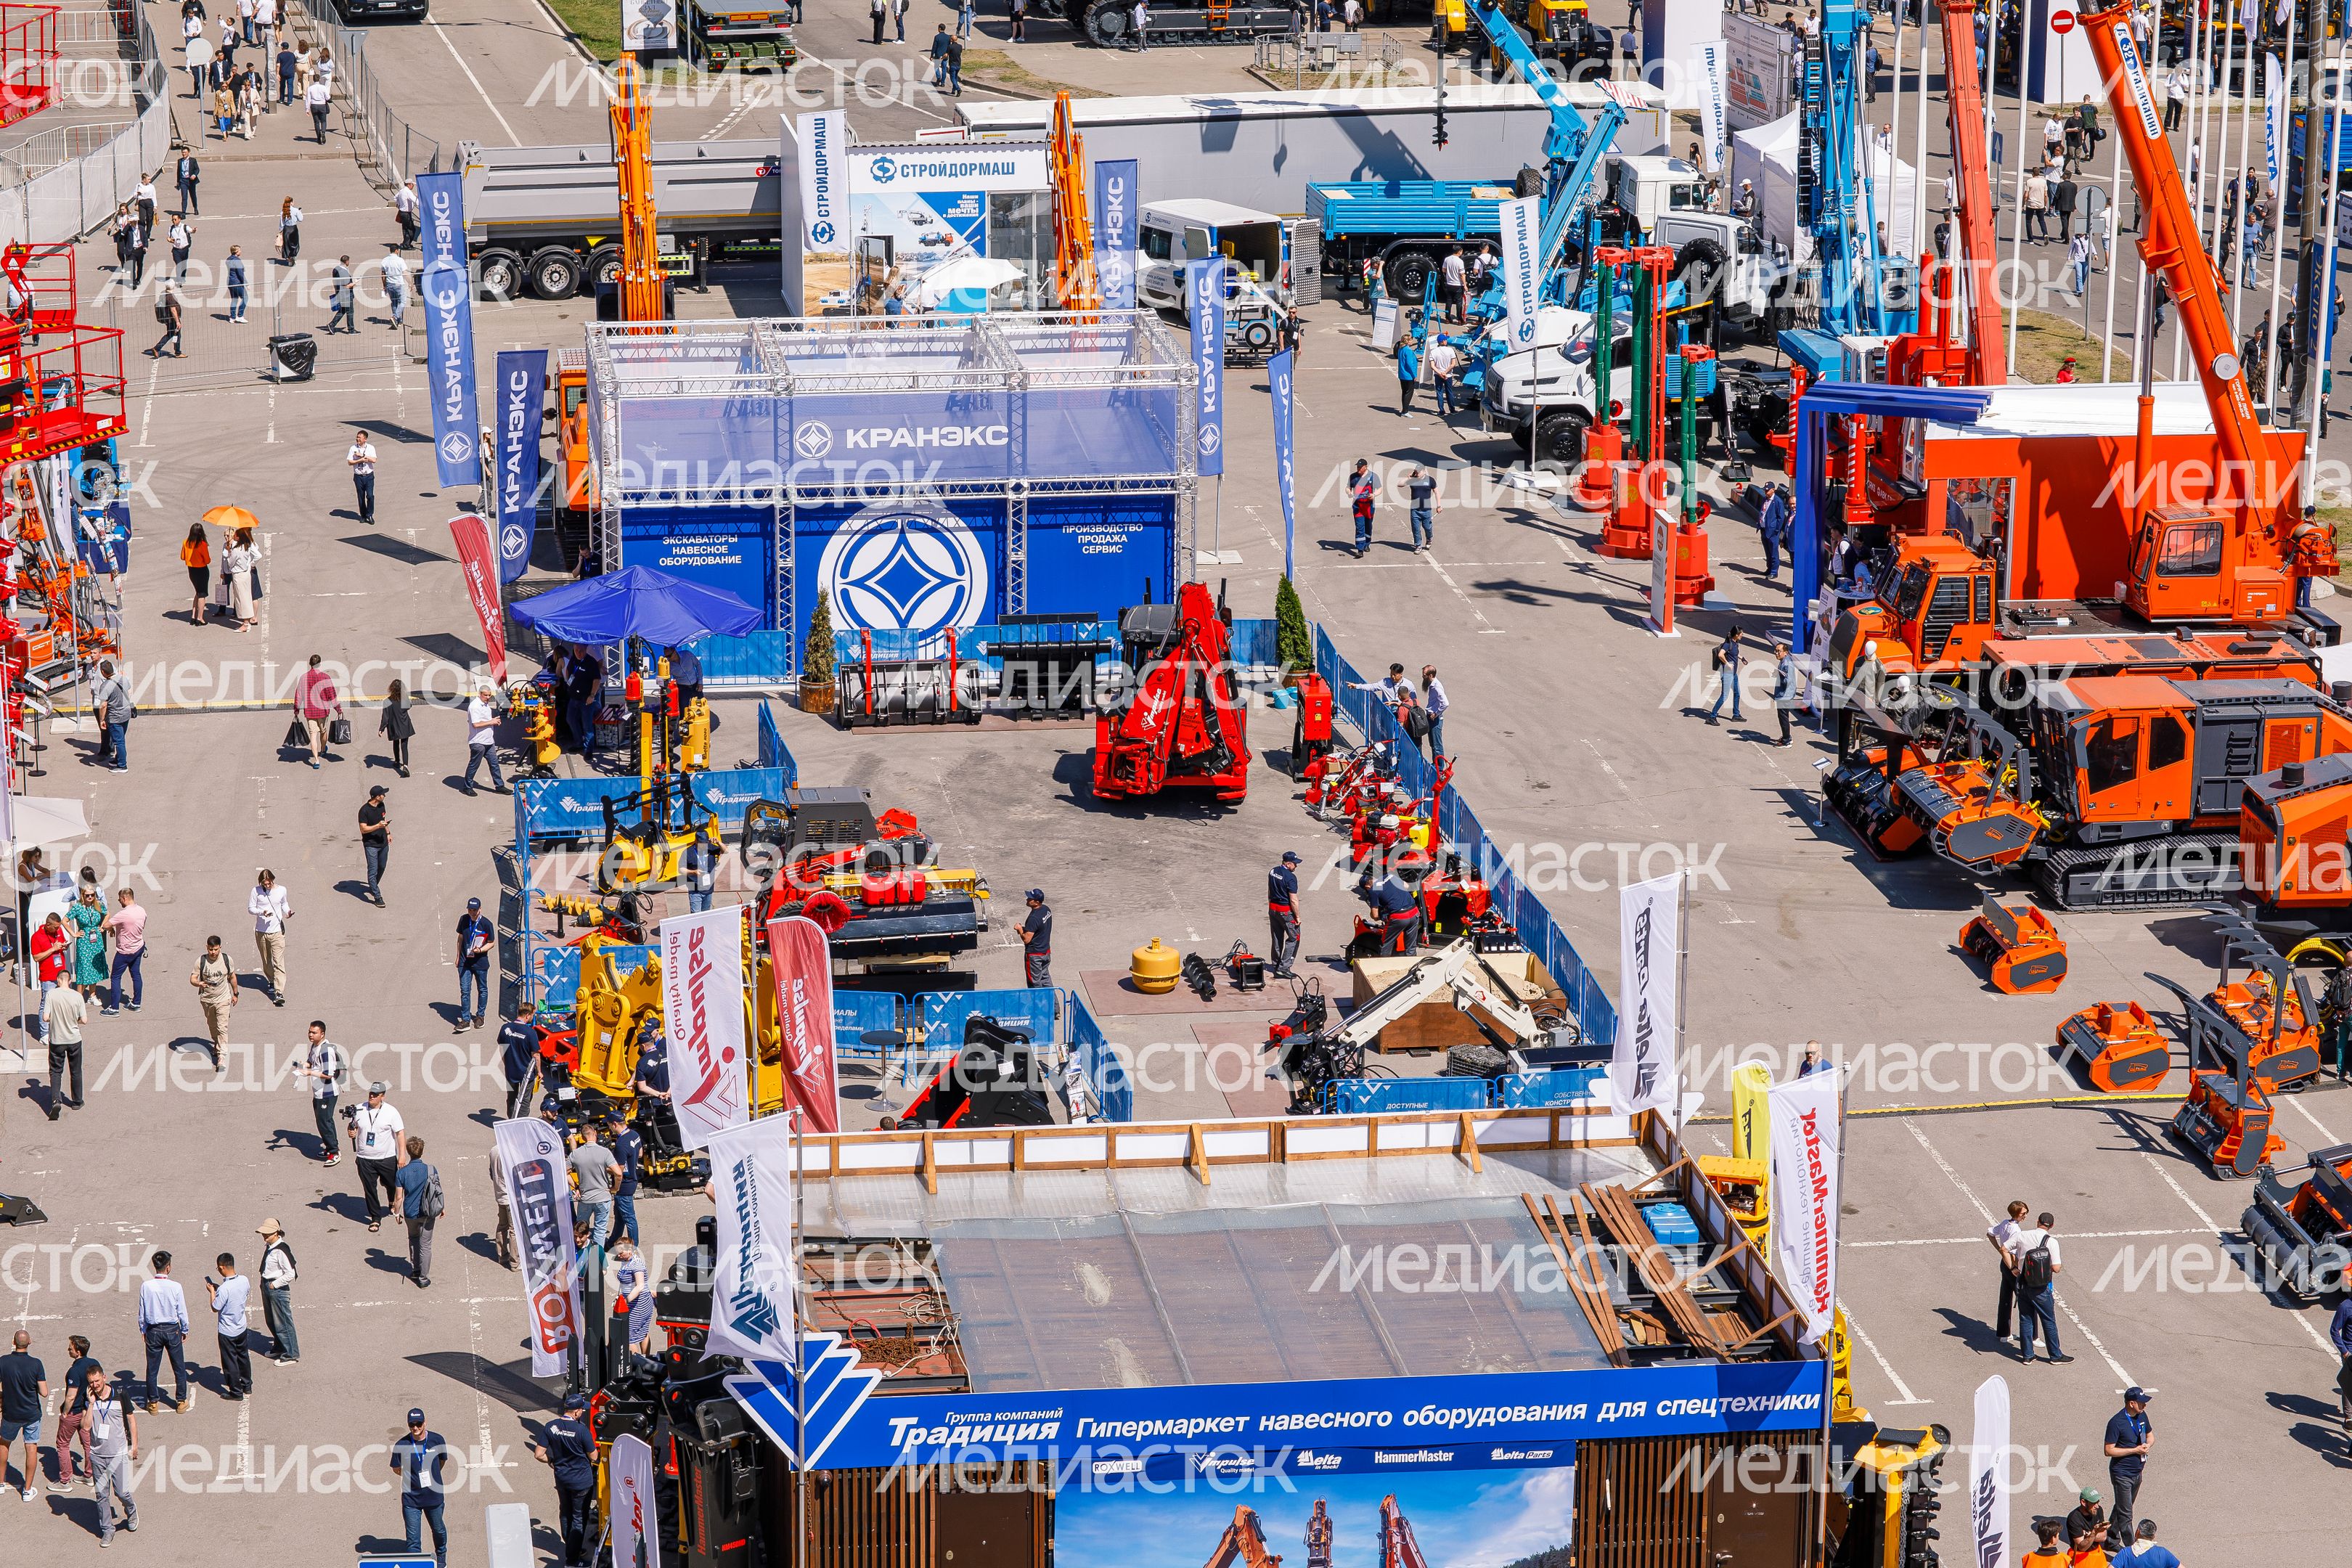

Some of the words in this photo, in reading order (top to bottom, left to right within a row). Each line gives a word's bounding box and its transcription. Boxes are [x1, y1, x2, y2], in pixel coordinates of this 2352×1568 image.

[1704, 46, 1724, 139] СТРОЙДОРМАШ
[2132, 70, 2159, 136] Галичанин
[812, 117, 827, 218] СТРОЙДОРМАШ
[900, 160, 1016, 179] СТРОЙДОРМАШ
[1516, 204, 1534, 315] СТРОЙДОРМАШ
[505, 370, 528, 514] КРАНЭКС
[846, 425, 1009, 449] КРАНЭКС
[1062, 523, 1144, 534] ПРОИЗВОДСТВО
[662, 535, 739, 544] ЭКСКАВАТОРЫ
[1077, 534, 1129, 544] ПРОДАЖА
[672, 545, 729, 555] НАВЕСНОЕ
[1082, 544, 1124, 555] СЕРВИС
[658, 555, 743, 567] ОБОРУДОВАНИЕ
[945, 1410, 991, 1426] Группа
[995, 1406, 1063, 1424] компаний
[1077, 1415, 1250, 1444] Гипермаркет
[1259, 1406, 1393, 1429] навесного
[1403, 1400, 1588, 1430] оборудования
[1598, 1397, 1646, 1420] для
[1657, 1392, 1821, 1418] спецтехники
[889, 1416, 1062, 1451] Традиция
[1201, 1451, 1255, 1469] impulse
[1375, 1450, 1455, 1463] HammerMaster
[1527, 1450, 1553, 1459] Parts
[1094, 1461, 1140, 1473] ROXWELL
[693, 1466, 706, 1556] HammerMaster
